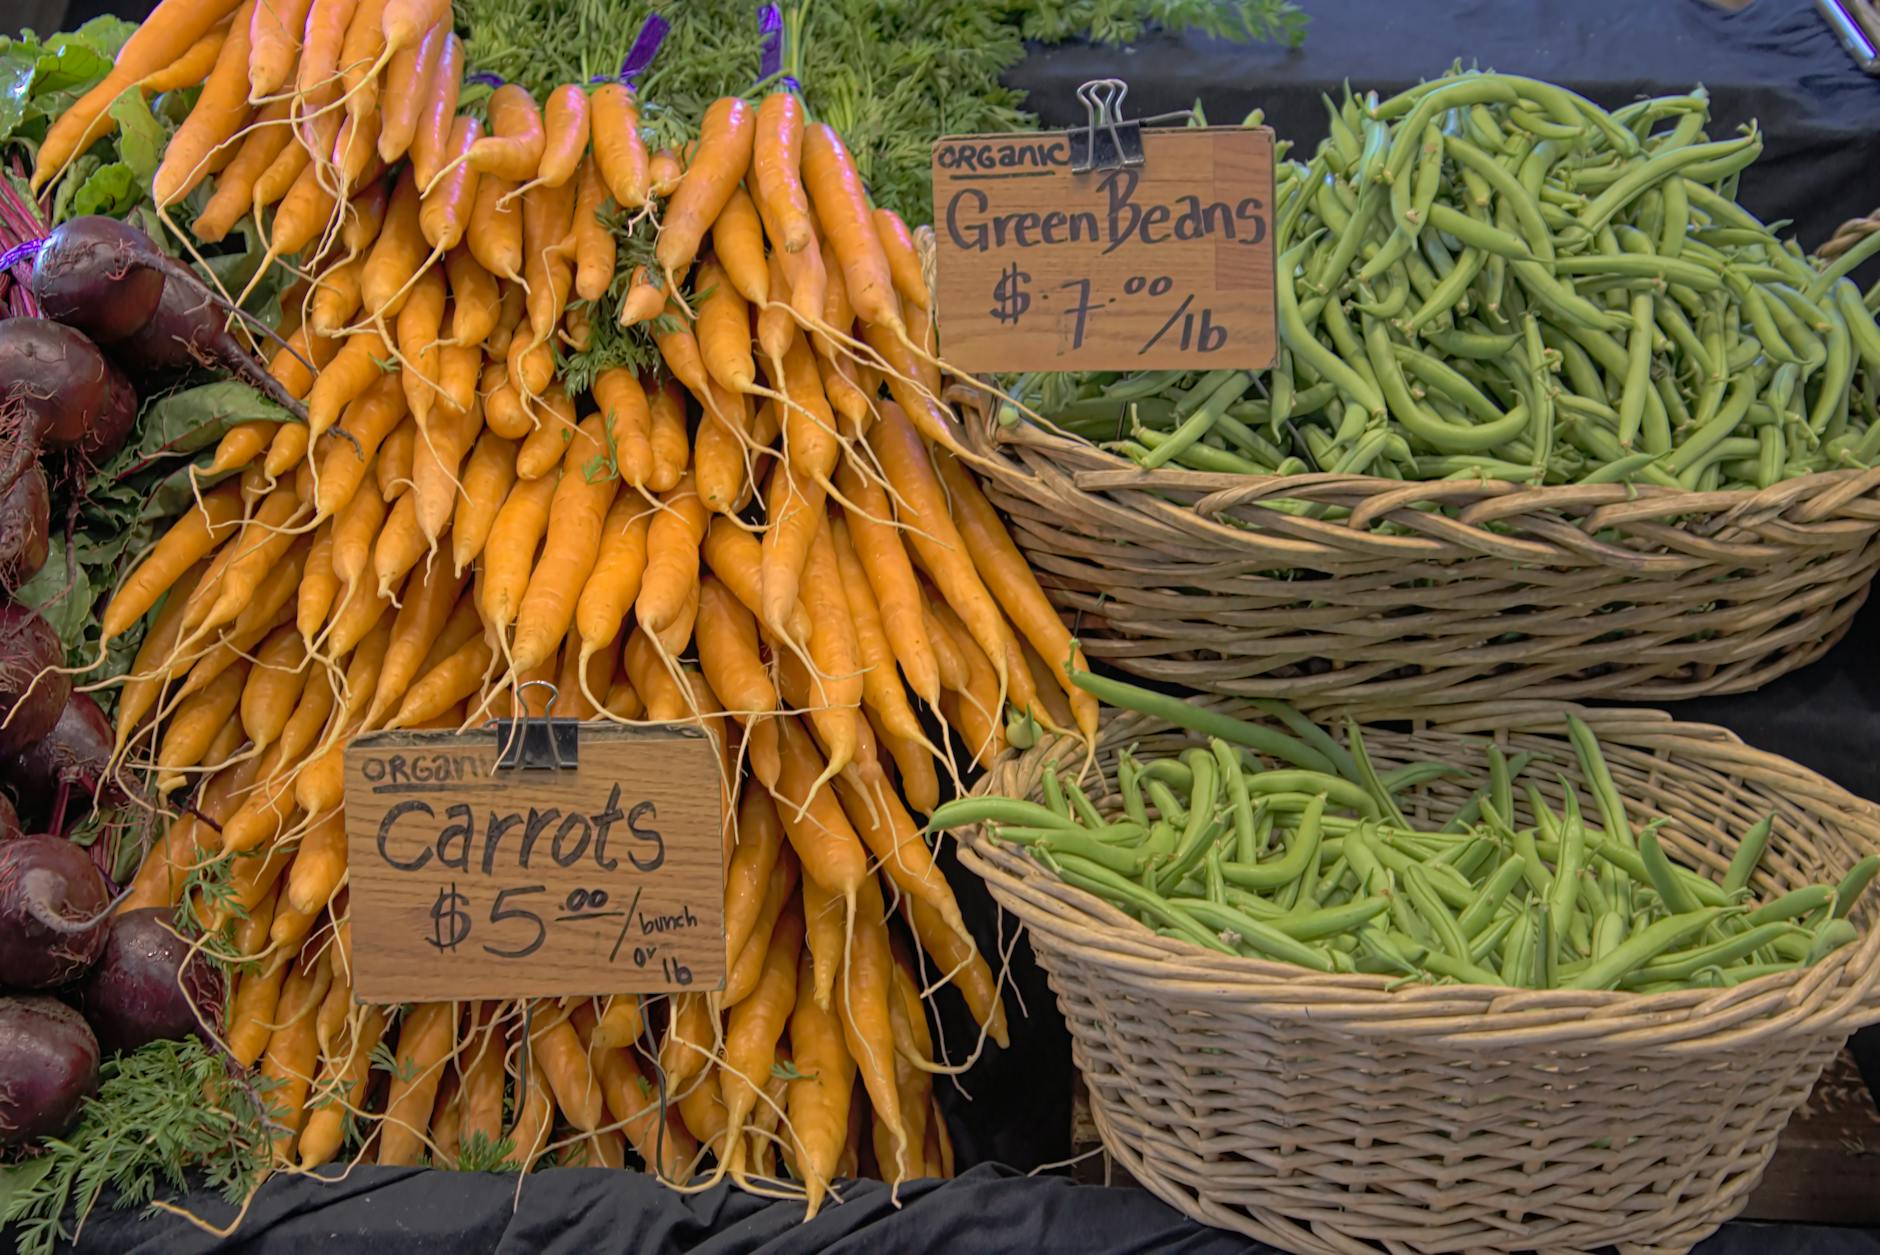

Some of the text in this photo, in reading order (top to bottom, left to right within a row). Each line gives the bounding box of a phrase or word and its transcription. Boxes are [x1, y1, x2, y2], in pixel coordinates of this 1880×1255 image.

[946, 168, 1267, 255] Green Beans
[377, 782, 665, 875] Carrots
